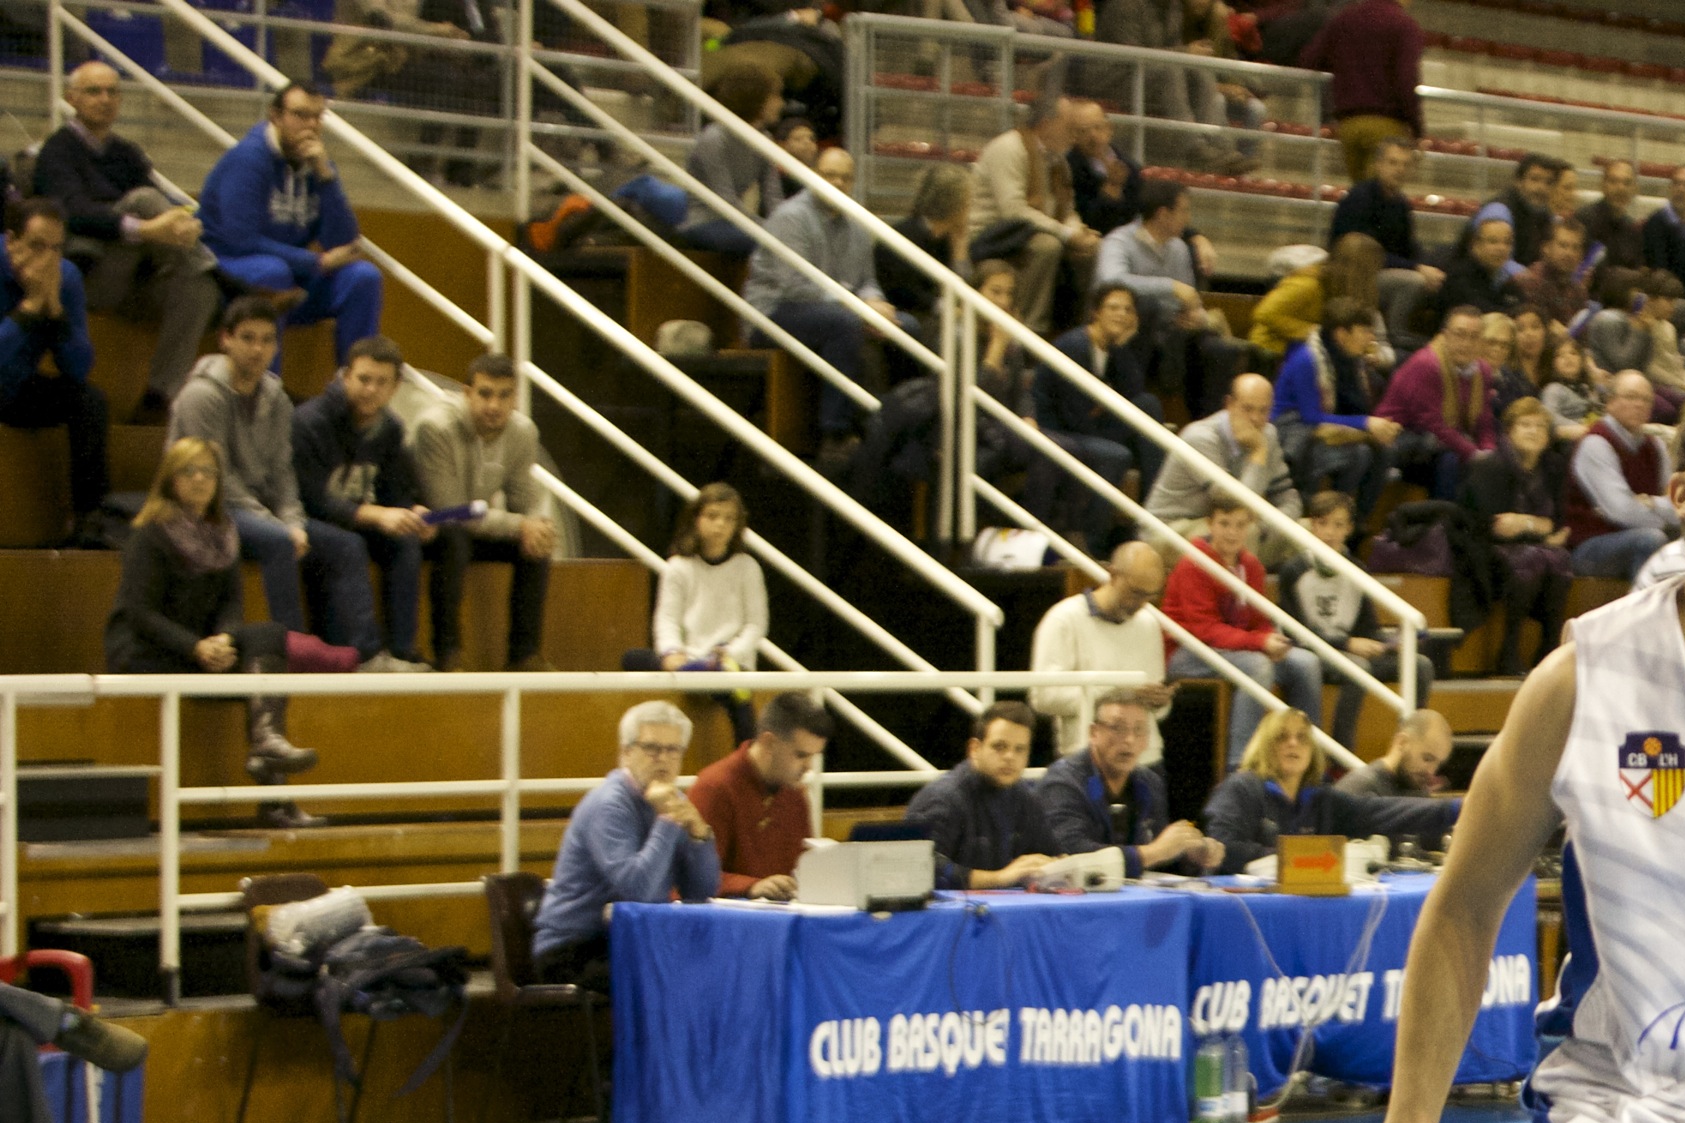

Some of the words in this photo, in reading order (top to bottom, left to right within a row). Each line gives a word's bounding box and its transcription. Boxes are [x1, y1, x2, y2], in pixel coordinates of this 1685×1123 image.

[1627, 752, 1647, 767] CB
[810, 1017, 882, 1079] CLUB
[1020, 1004, 1182, 1063] TARRAGONA
